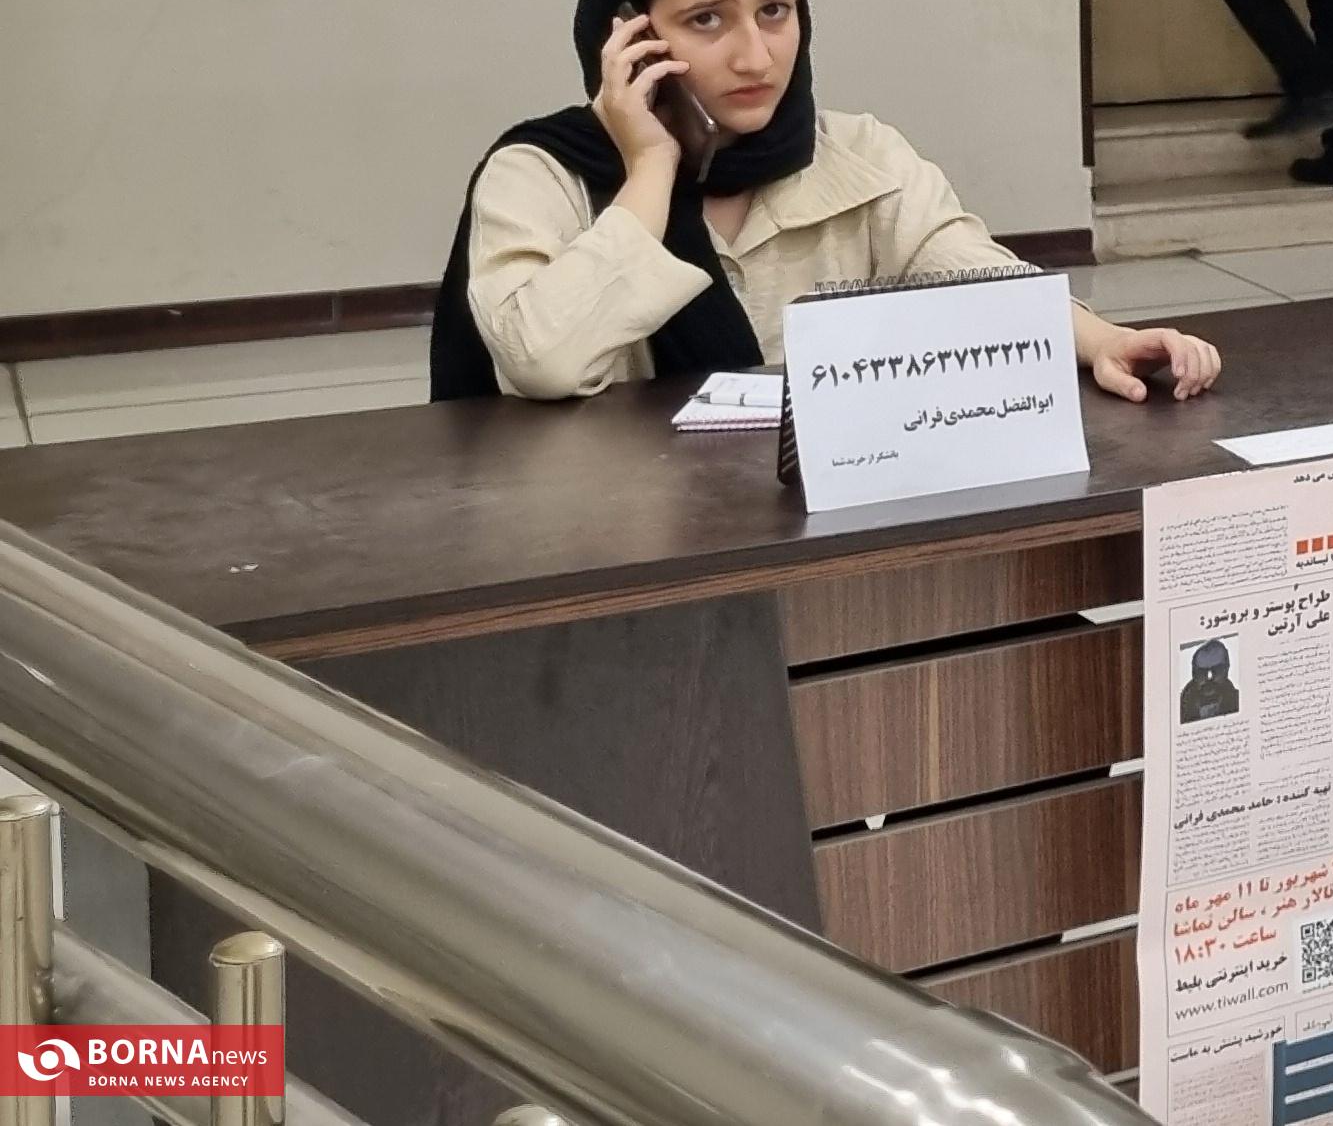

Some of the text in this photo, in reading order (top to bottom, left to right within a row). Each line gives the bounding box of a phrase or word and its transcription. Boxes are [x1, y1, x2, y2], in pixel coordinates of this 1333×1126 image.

[902, 392, 1055, 432] ابوالفضل محمدی فرانی
[1292, 472, 1311, 485] دهد
[1263, 599, 1296, 618] پوستر
[1298, 589, 1331, 610] طراح
[1252, 607, 1260, 620] و
[1267, 609, 1331, 637] علی آرتین
[1282, 785, 1311, 802] کننده
[1313, 781, 1332, 796] تهیه
[1206, 805, 1246, 823] محمدی
[1248, 796, 1274, 811] حامد
[1173, 809, 1204, 830] فرانی
[1258, 875, 1270, 893] تا
[1275, 863, 1329, 894] شهریور
[1237, 880, 1253, 900] ۱۱
[1174, 895, 1200, 914] ماه
[1205, 890, 1232, 912] مهر
[1272, 896, 1297, 919] هنر
[1173, 914, 1214, 938] تماشا
[1217, 904, 1257, 932] سالن
[1232, 925, 1277, 950] ساعت
[1174, 951, 1288, 994] خرید اینترنتی بلیط
[1174, 980, 1289, 1021] www.tiwall.com
